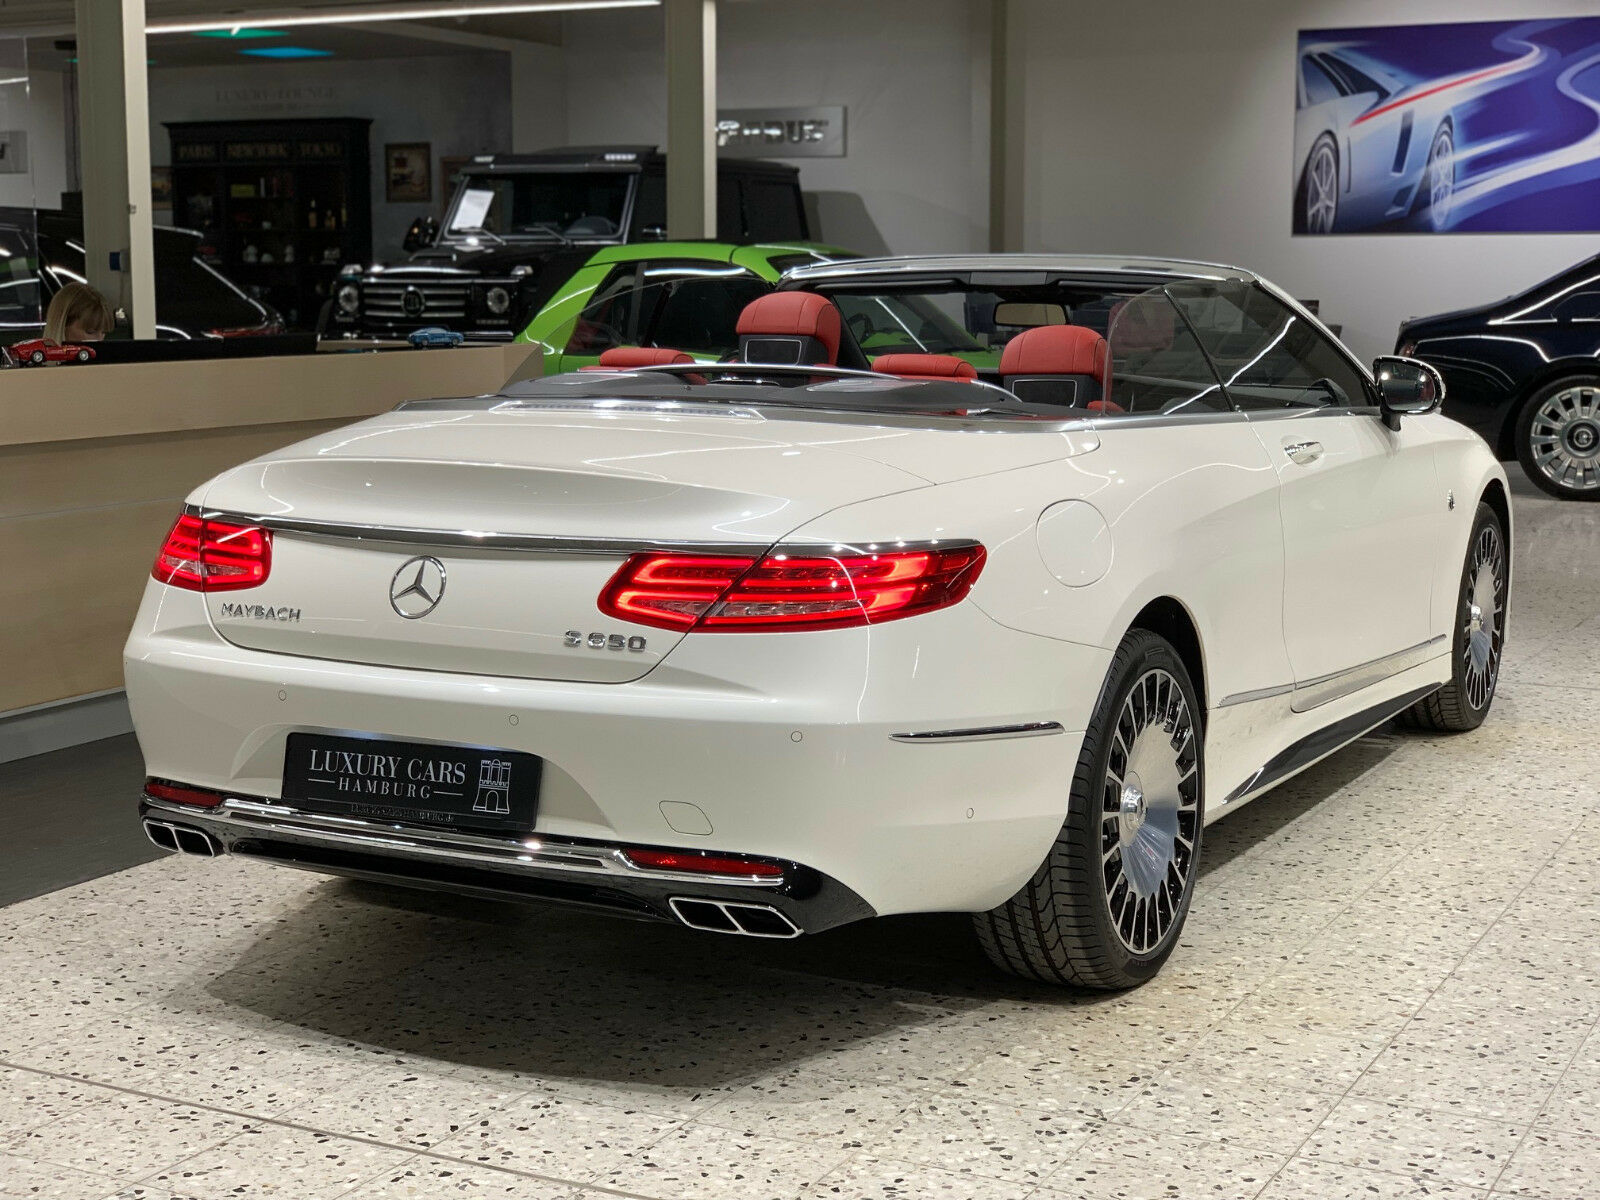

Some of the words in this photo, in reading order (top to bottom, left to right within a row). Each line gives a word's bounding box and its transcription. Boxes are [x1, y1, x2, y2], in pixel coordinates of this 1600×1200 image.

[221, 602, 302, 622] MAYBACH
[563, 630, 582, 648] S
[587, 632, 647, 653] 650
[309, 749, 402, 779] LUXURY
[407, 758, 466, 785] CARS
[338, 777, 431, 799] HAMBURG
